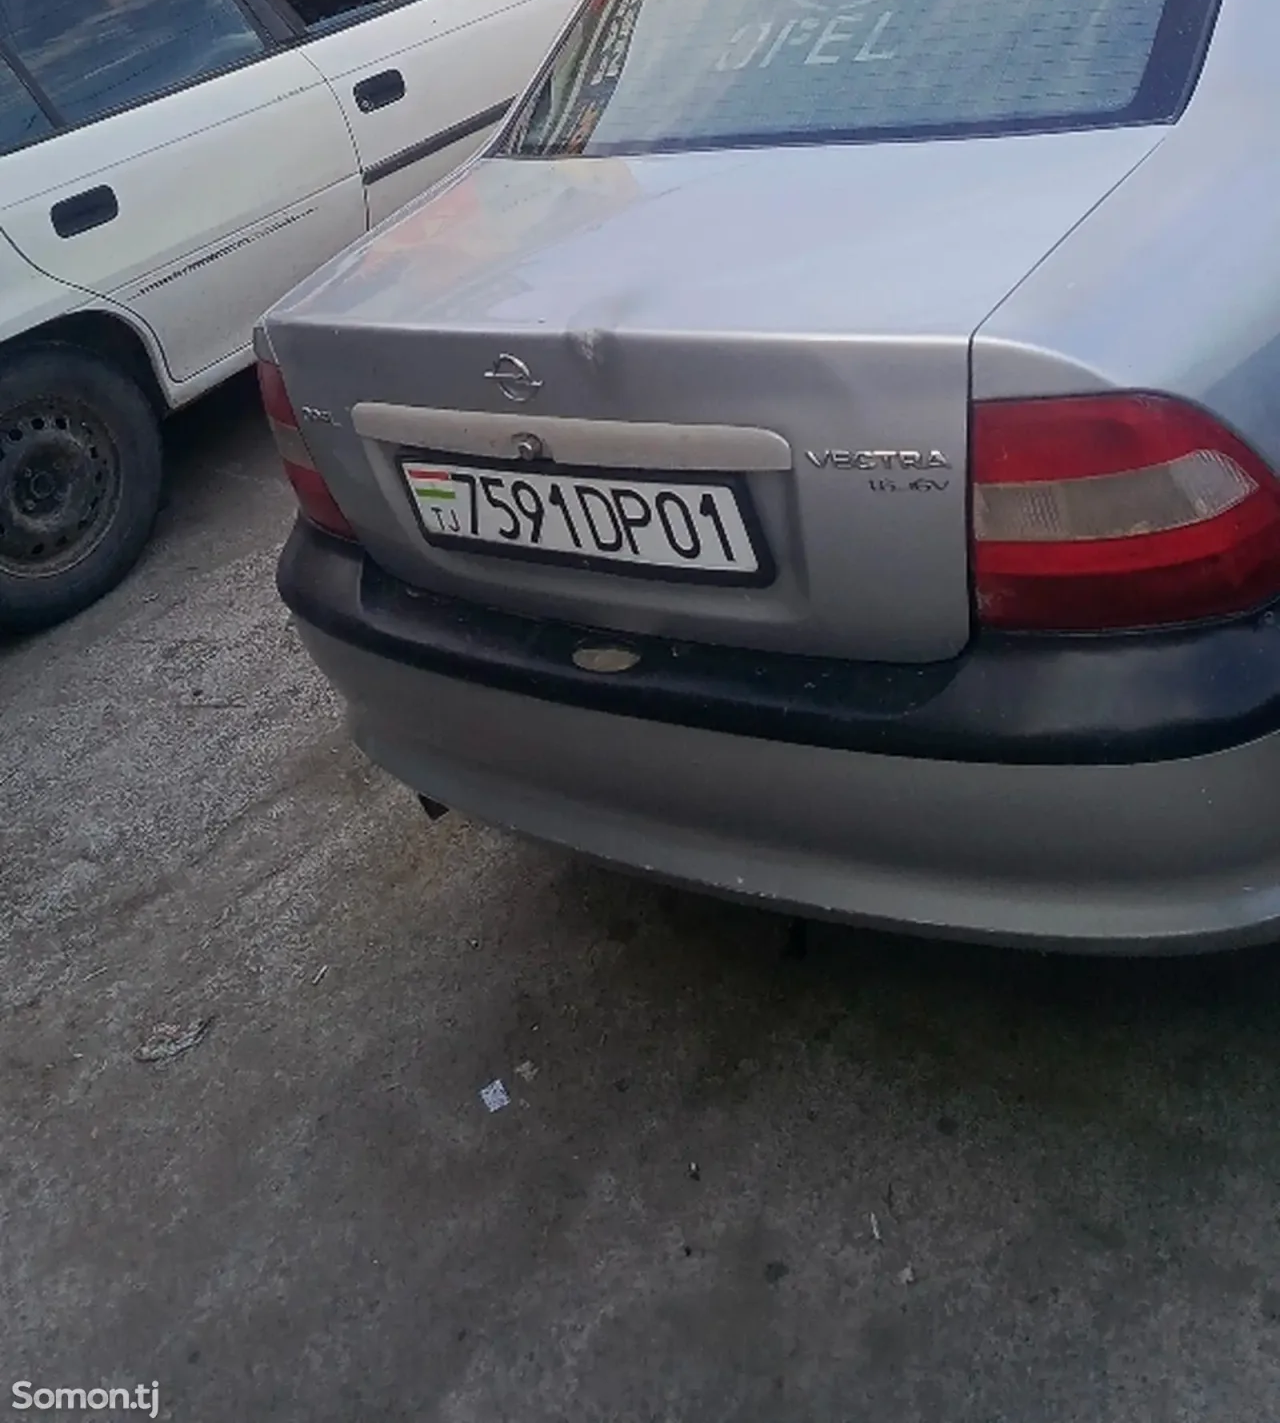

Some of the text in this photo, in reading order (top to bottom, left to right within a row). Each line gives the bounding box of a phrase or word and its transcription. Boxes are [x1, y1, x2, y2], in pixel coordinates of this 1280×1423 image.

[714, 10, 895, 71] OPEL
[804, 449, 953, 470] VECTRA
[430, 506, 461, 533] TJ
[450, 473, 736, 562] 7591DP01
